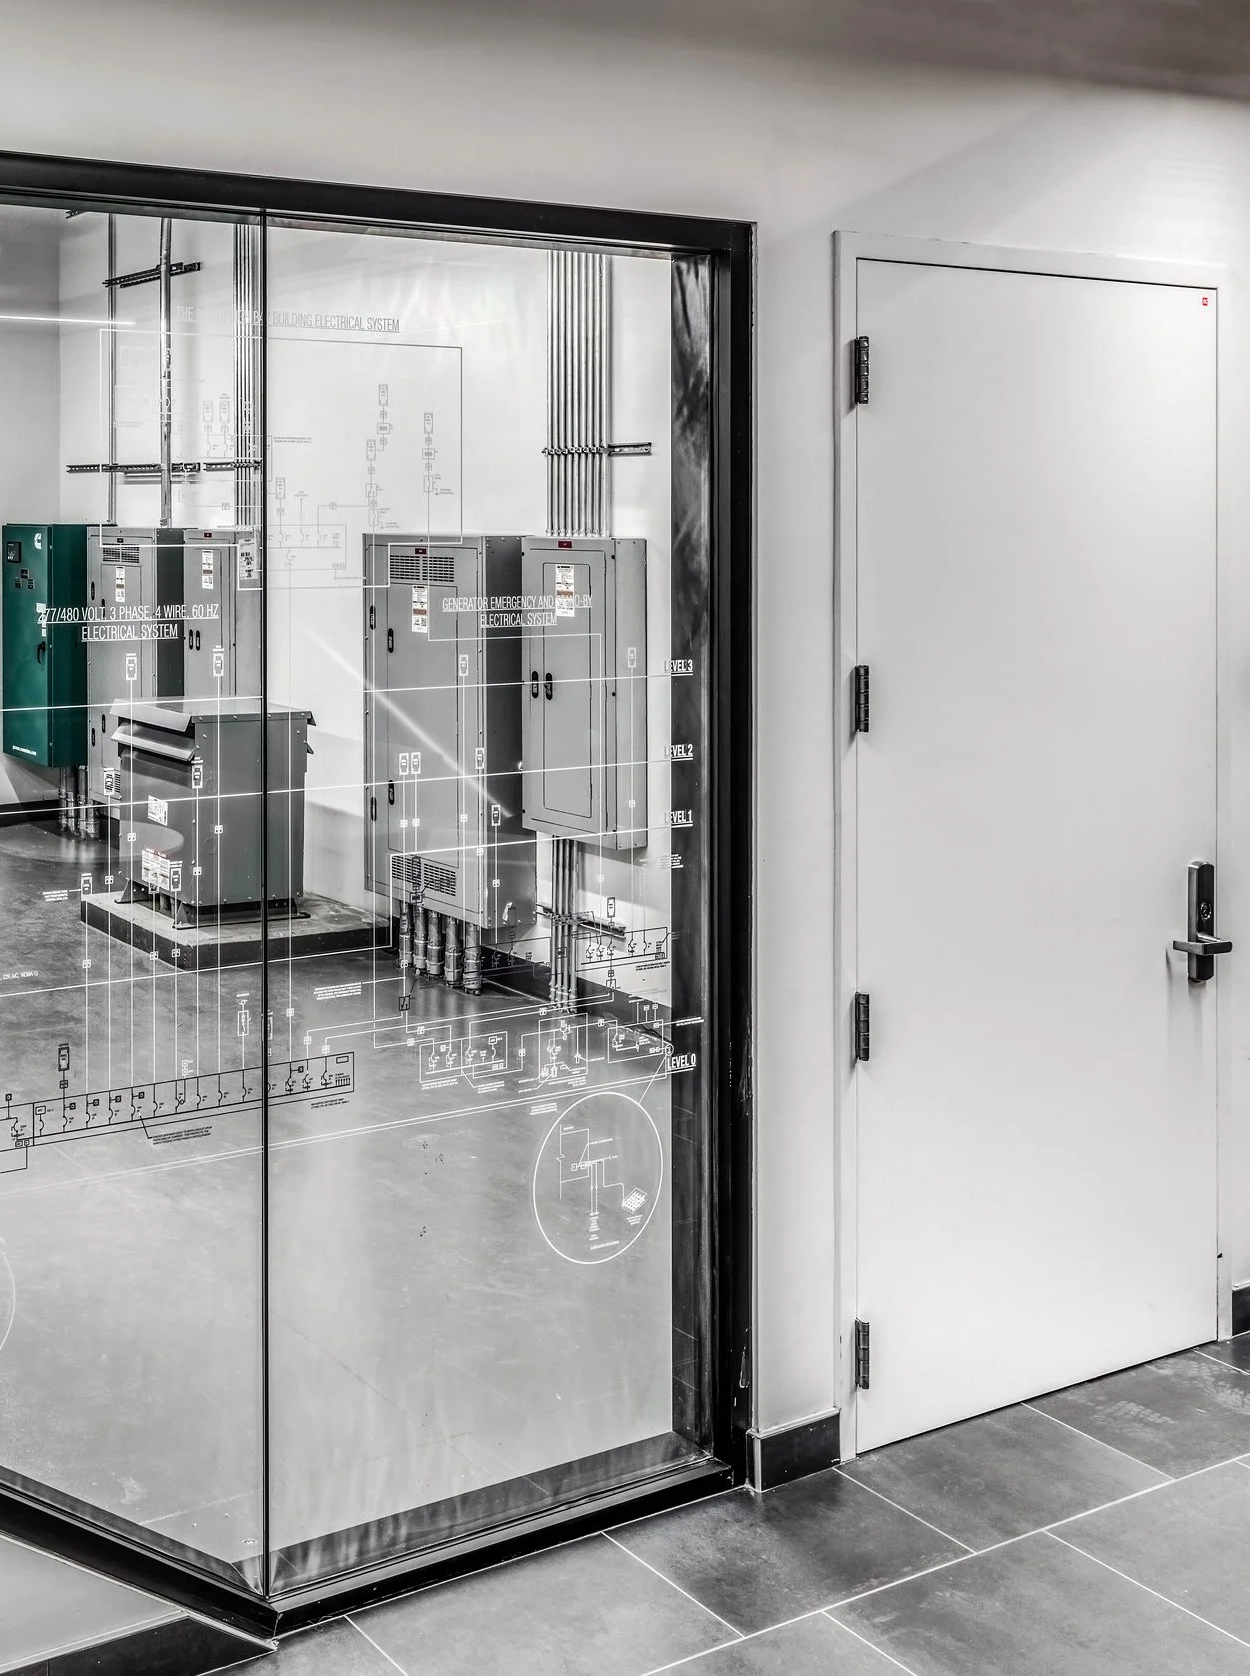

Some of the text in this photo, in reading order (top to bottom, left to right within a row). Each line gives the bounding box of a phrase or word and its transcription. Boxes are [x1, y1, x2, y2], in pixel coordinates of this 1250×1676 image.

[273, 311, 312, 326] BUILDING
[314, 314, 365, 330] ELECTRICAL
[366, 317, 401, 332] SYSTEM
[442, 594, 593, 610] GENERATOR EMERGENCY AND D-BY
[109, 606, 117, 621] 3
[155, 605, 162, 619] 4
[191, 604, 204, 618] 60
[206, 603, 220, 618] HZ
[481, 612, 558, 627] ELECTRICAL SYSTEM
[81, 624, 178, 641] ELECTRICAL SYSTEM
[664, 659, 693, 672] LEVEL 3
[664, 743, 693, 757] LEVEL 2
[687, 810, 693, 822] 1
[667, 1052, 696, 1068] LEVEL 0
